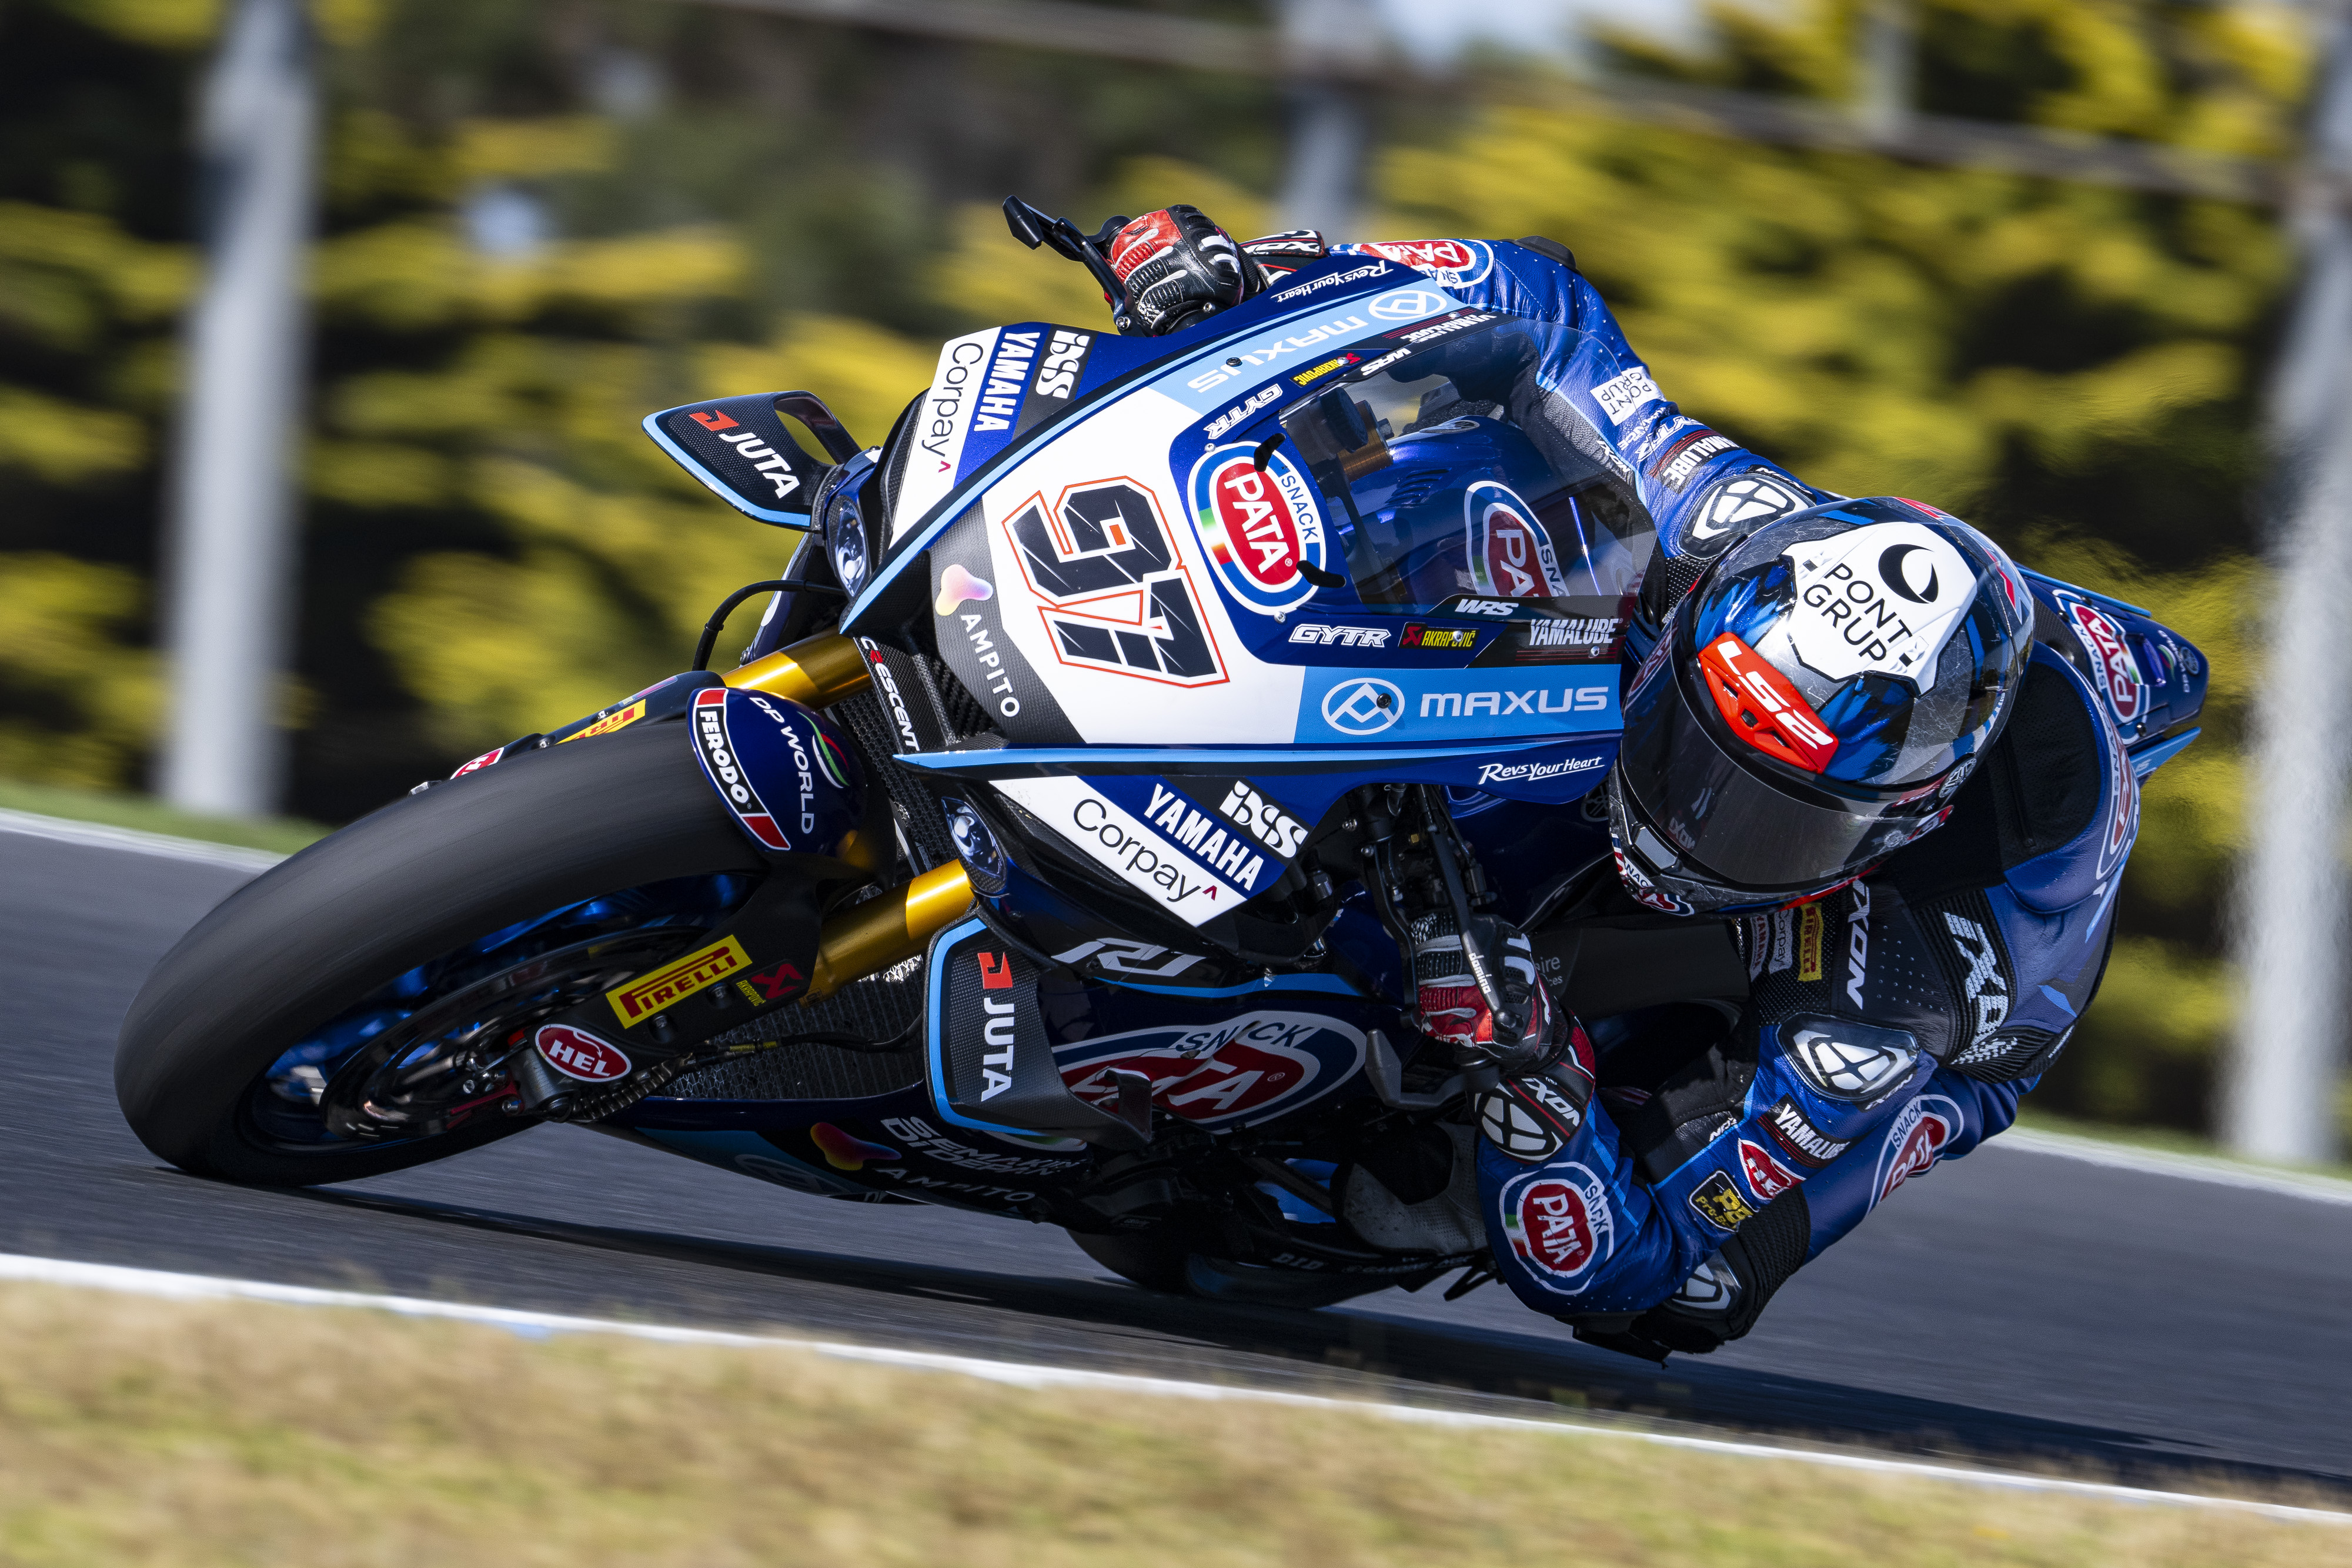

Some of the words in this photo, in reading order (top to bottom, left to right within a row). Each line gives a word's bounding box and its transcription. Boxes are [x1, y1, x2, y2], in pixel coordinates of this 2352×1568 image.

[921, 343, 984, 457] Corpay
[973, 332, 1041, 432] YAMAHA
[1361, 348, 1412, 376] WRS
[1203, 383, 1284, 439] GYTR
[719, 432, 800, 499] JUTA
[1223, 472, 1284, 574] PATA
[1281, 474, 1319, 543] SNACK
[1002, 476, 1230, 688] 97
[1496, 530, 1541, 597] PA
[1289, 623, 1391, 648] GYTR
[1455, 599, 1519, 616] WRS
[1528, 618, 1617, 646] YAMALUBE
[1803, 583, 1887, 662] GRUP
[1825, 562, 1913, 646] PONT
[861, 636, 921, 752] CRESCENT
[960, 614, 1020, 717] AMPITO
[1717, 640, 1834, 751] LS2
[2087, 617, 2133, 703] PATA
[1419, 687, 1609, 718] MAXUS
[700, 710, 750, 804] FERODO
[749, 697, 786, 724] DP
[780, 726, 814, 834] WORLD
[1073, 798, 1201, 903] Corpay
[1144, 783, 1264, 891] YAMAHA
[619, 946, 738, 1019] PIRELLI
[1469, 952, 1492, 994] domino
[549, 1039, 611, 1077] HEL
[981, 997, 1015, 1102] JUTA
[1892, 1103, 1923, 1148] SNACK
[1532, 1193, 1582, 1265] PATA
